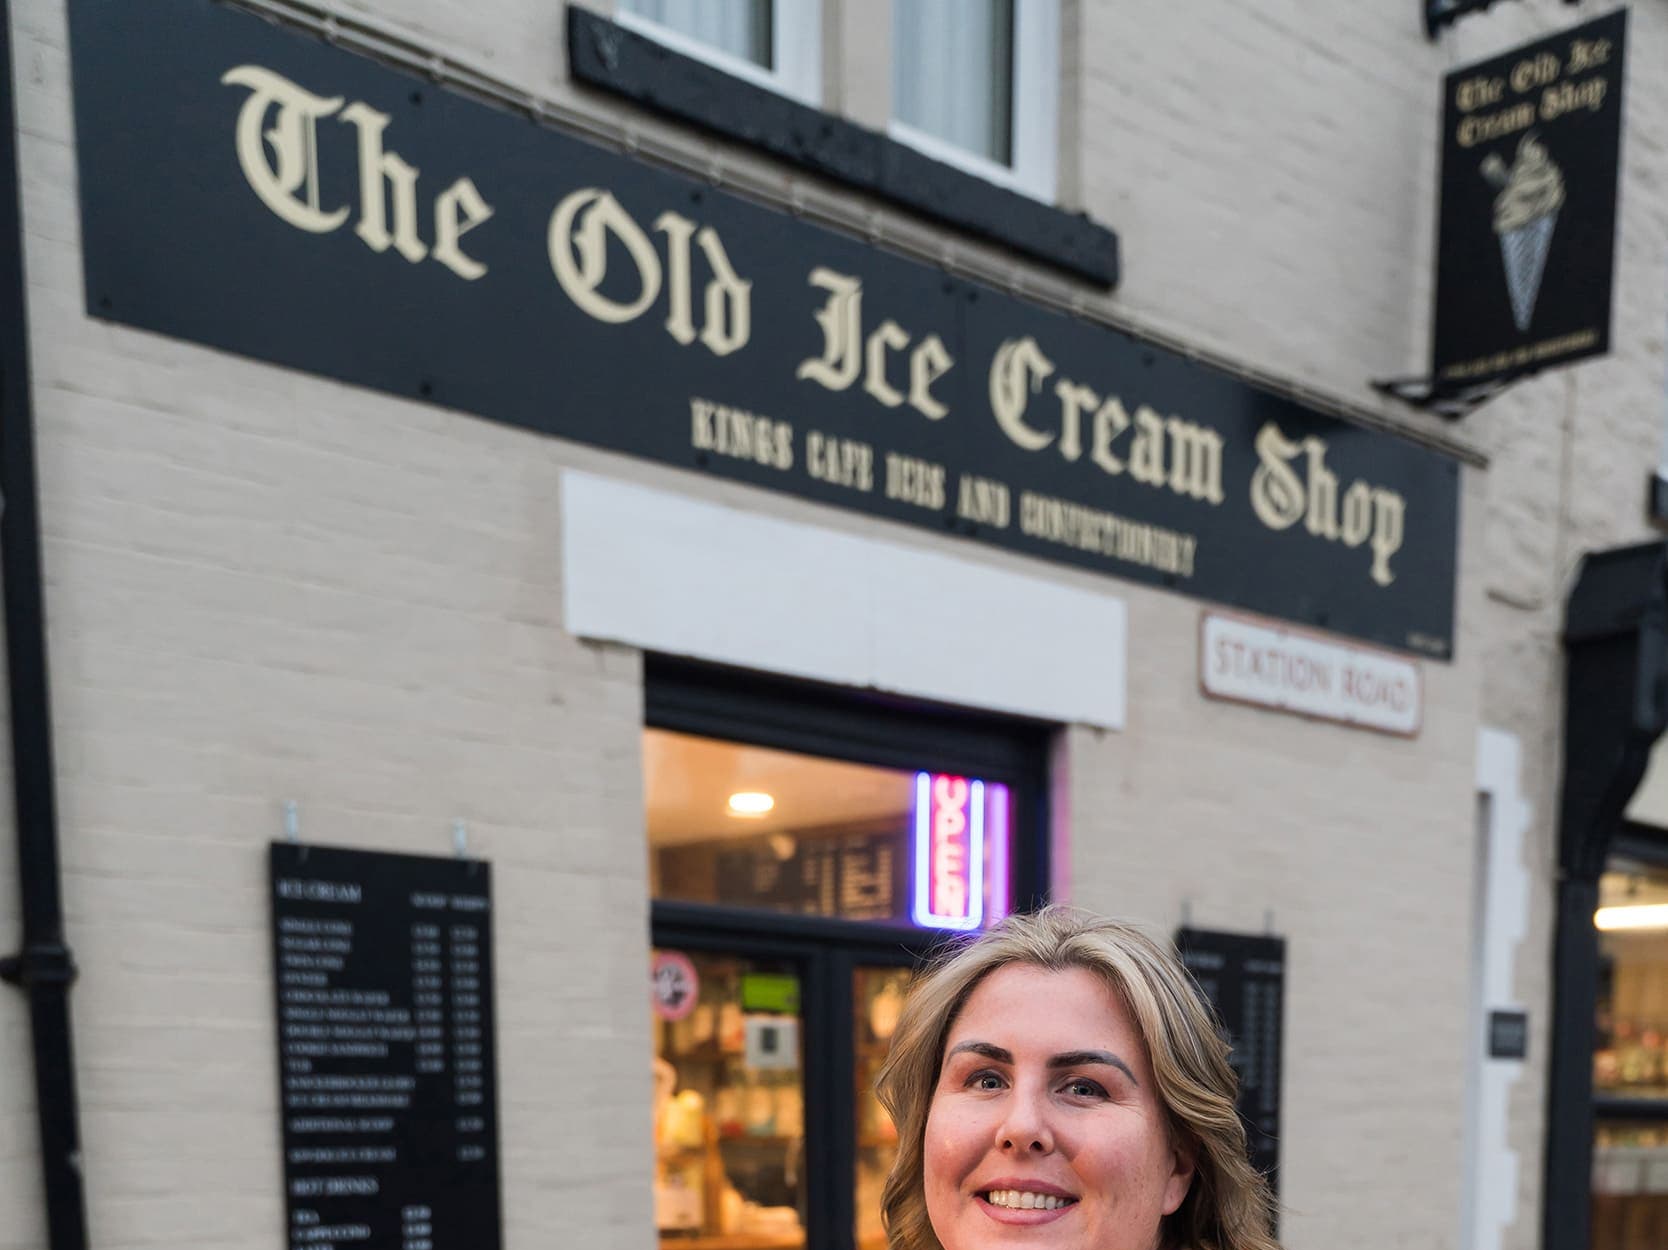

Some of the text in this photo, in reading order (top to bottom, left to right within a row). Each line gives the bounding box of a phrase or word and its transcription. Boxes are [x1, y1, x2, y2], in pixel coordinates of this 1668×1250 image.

[220, 64, 1405, 586] The Old Ice Cream Shop
[690, 397, 793, 471] KINGS
[806, 430, 873, 492] CAFE
[956, 473, 1011, 528] AND
[1215, 635, 1409, 713] STATION ROAD
